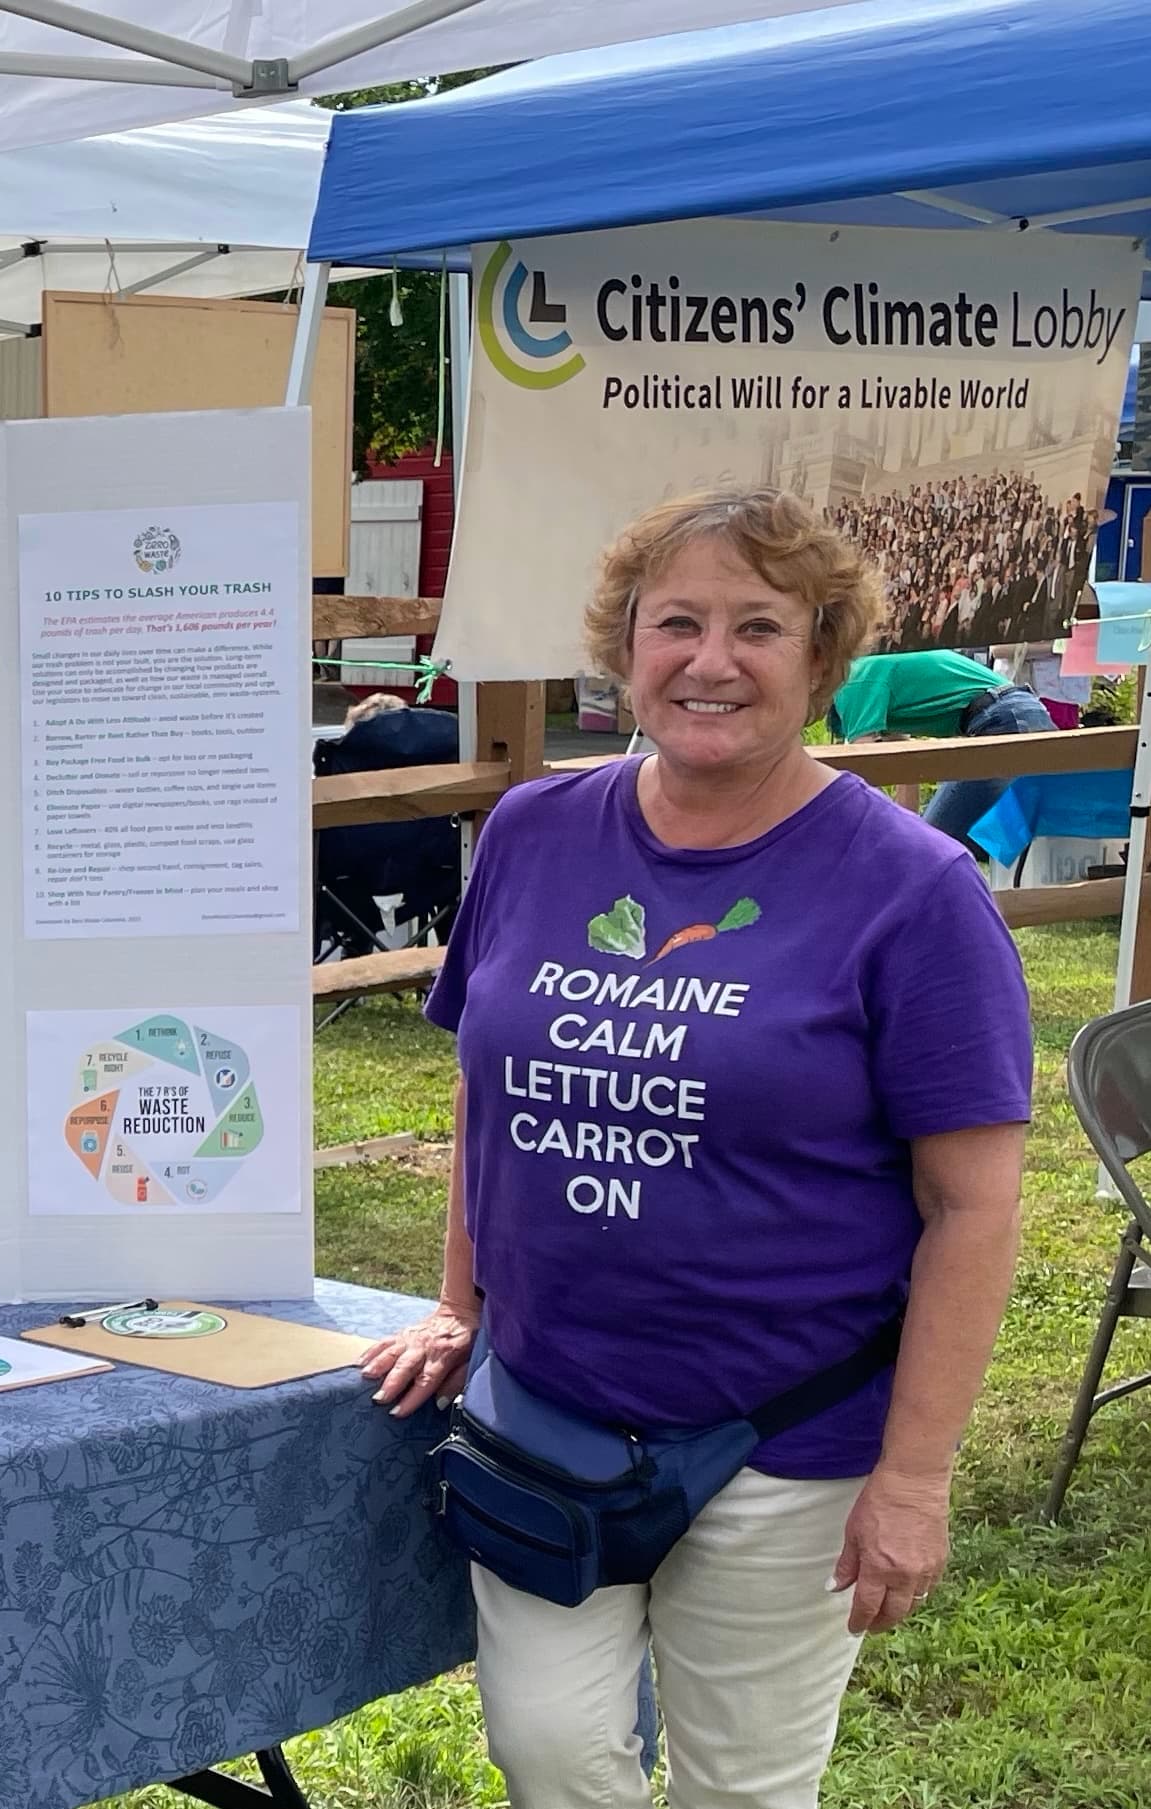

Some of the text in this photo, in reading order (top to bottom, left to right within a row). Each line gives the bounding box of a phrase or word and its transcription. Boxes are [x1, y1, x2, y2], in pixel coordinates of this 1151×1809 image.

[823, 281, 997, 348] Climate
[1011, 287, 1127, 366] Lobby
[603, 375, 1029, 410] Political Will for a Livable World
[44, 582, 271, 602] 10 TIPS TO SLASH YOUR TRASH
[79, 614, 120, 624] estimates
[122, 613, 136, 622] the
[138, 613, 174, 623] average
[218, 609, 258, 619] produces
[40, 629, 72, 639] pounds
[85, 626, 107, 636] trash
[109, 627, 124, 636] per
[201, 621, 234, 632] pounds
[236, 621, 251, 630] per
[529, 961, 751, 1017] ROMAINE
[548, 1013, 688, 1062] CALM
[205, 1050, 232, 1060] REFUSE
[138, 1086, 154, 1097] THE
[156, 1086, 162, 1097] 7
[178, 1086, 189, 1097] OF
[504, 1056, 707, 1121] LETTUCE
[139, 1098, 189, 1116] WASTE
[123, 1116, 206, 1135] REDUCTION
[228, 1113, 256, 1123] REDUCE
[509, 1112, 700, 1169] CARROT
[565, 1174, 642, 1220] ON
